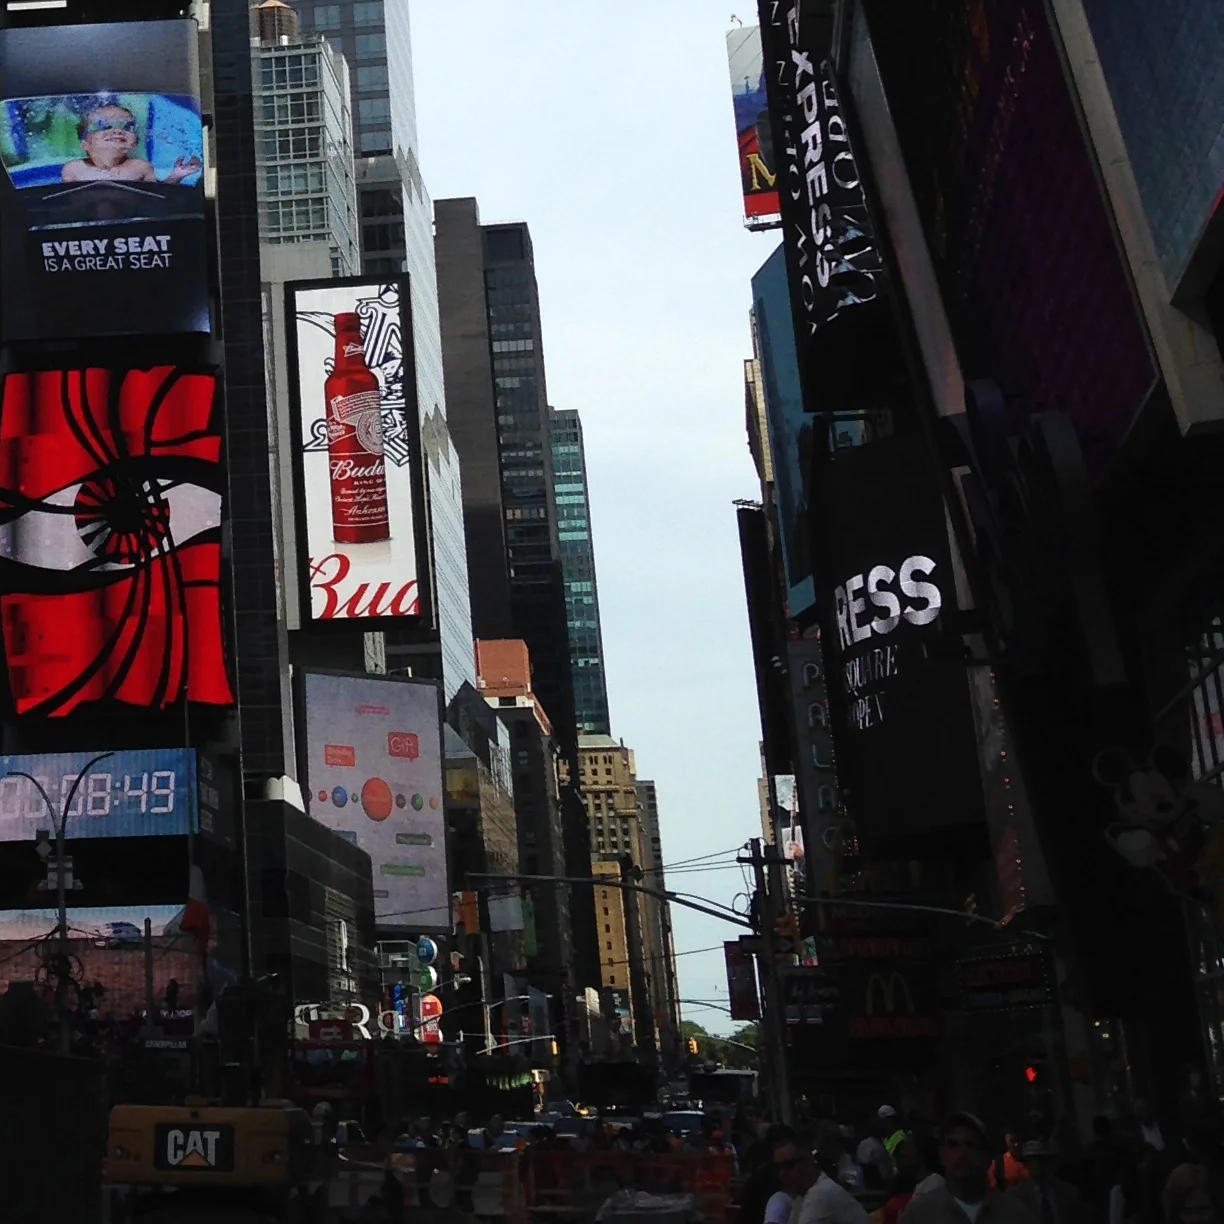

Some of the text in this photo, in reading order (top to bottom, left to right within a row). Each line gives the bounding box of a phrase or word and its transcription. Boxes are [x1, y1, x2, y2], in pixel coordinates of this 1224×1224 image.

[42, 235, 171, 256] EVERY SEAT
[44, 254, 172, 271] IS A GREAT SEAT
[167, 1129, 221, 1167] CAT
